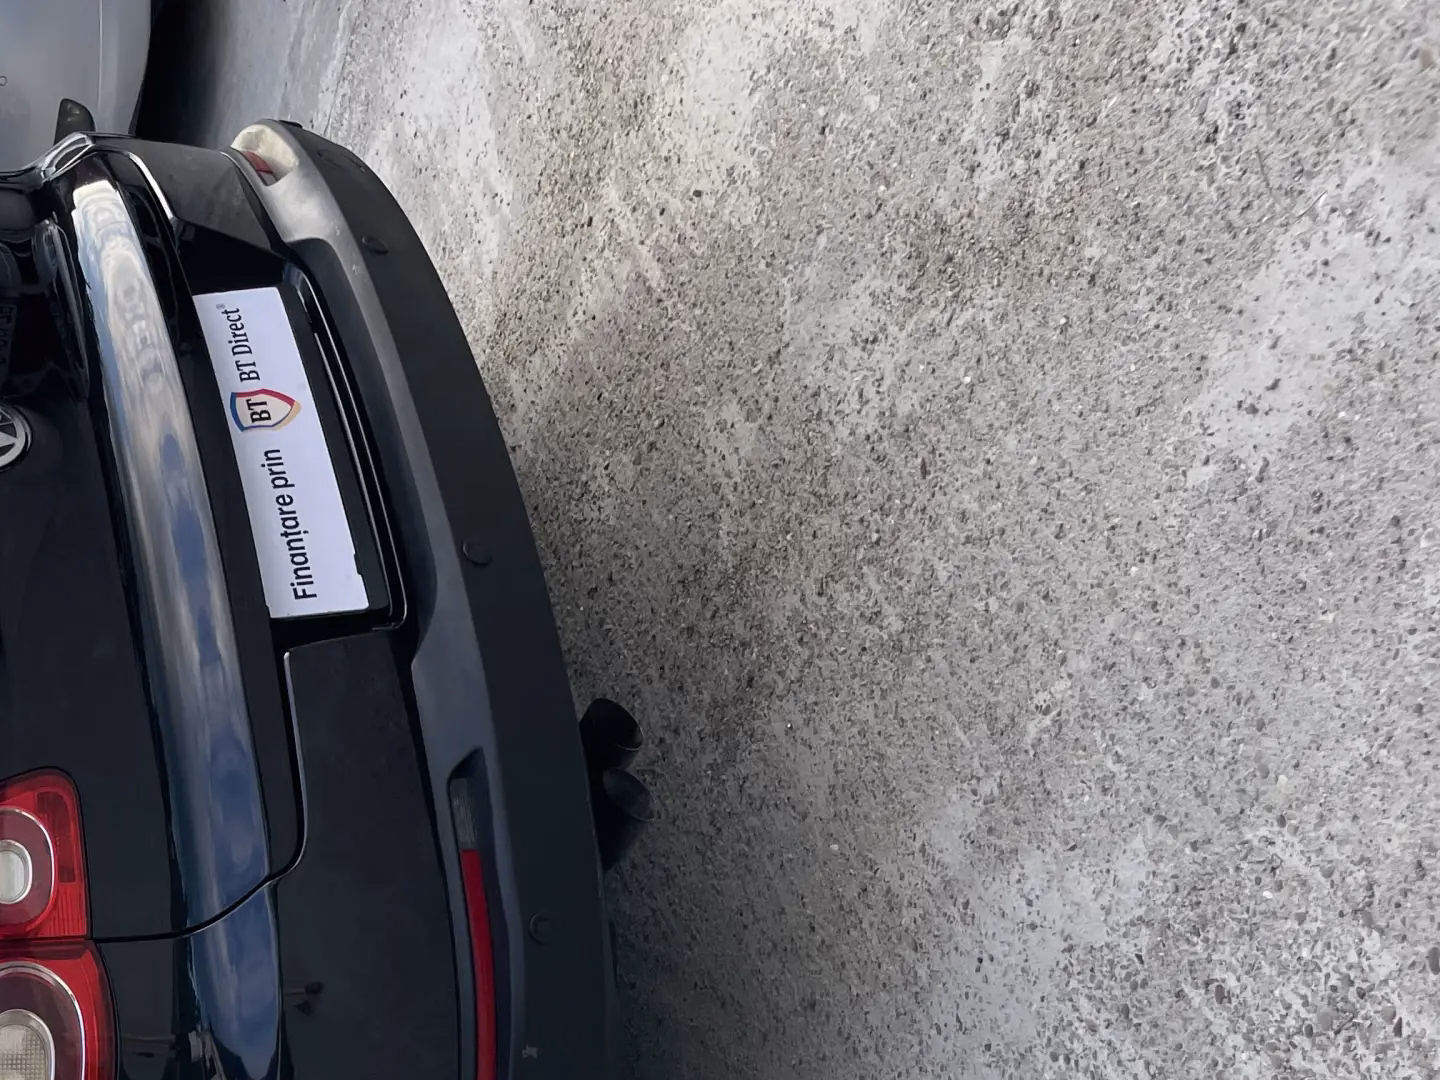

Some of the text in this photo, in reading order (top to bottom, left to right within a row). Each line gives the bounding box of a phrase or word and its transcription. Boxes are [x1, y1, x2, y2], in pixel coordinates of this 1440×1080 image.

[235, 360, 261, 383] BT
[245, 398, 273, 423] BT
[260, 449, 318, 600] Finanțare prin
